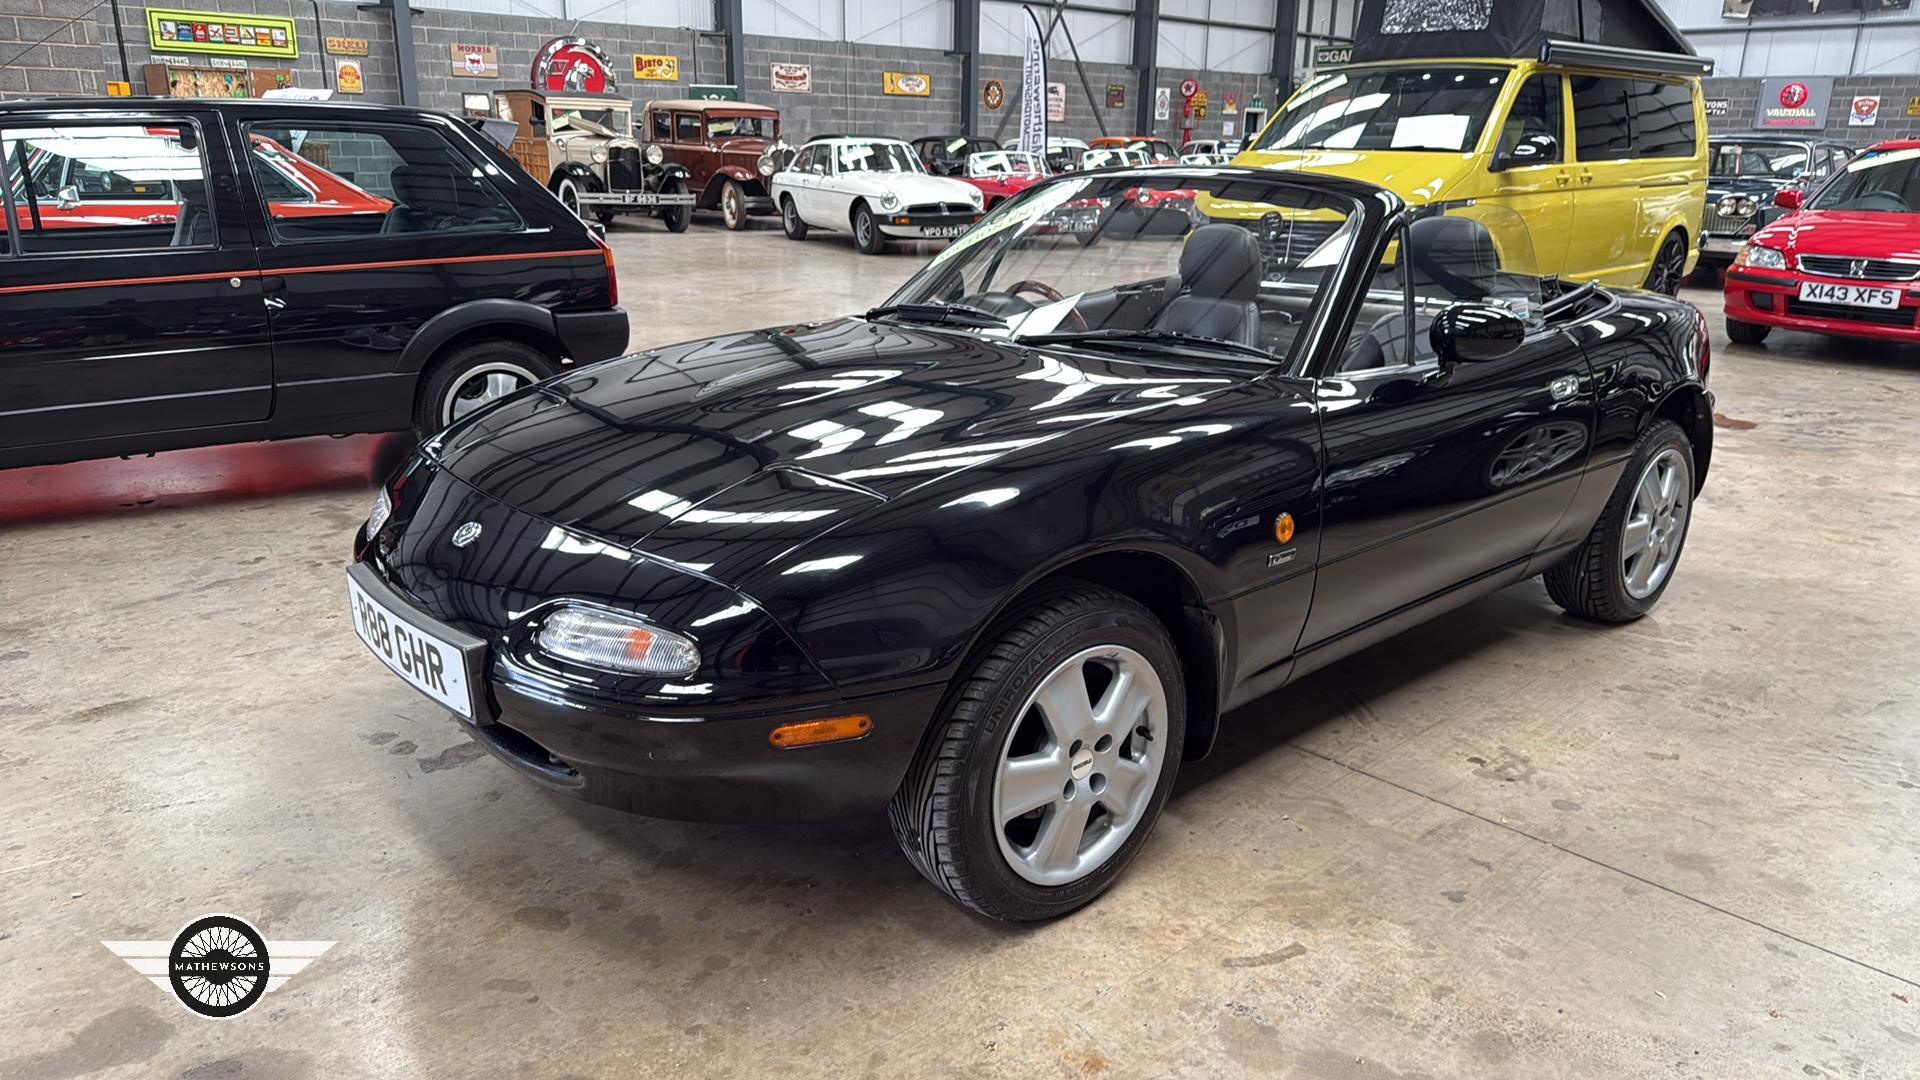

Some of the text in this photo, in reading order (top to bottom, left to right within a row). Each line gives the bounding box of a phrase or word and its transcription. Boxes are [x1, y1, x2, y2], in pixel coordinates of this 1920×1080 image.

[457, 44, 492, 54] MORRIS
[1766, 108, 1817, 117] VAUXHALL
[1806, 284, 1894, 305] X143 XFS
[357, 591, 448, 697] R88 GHR
